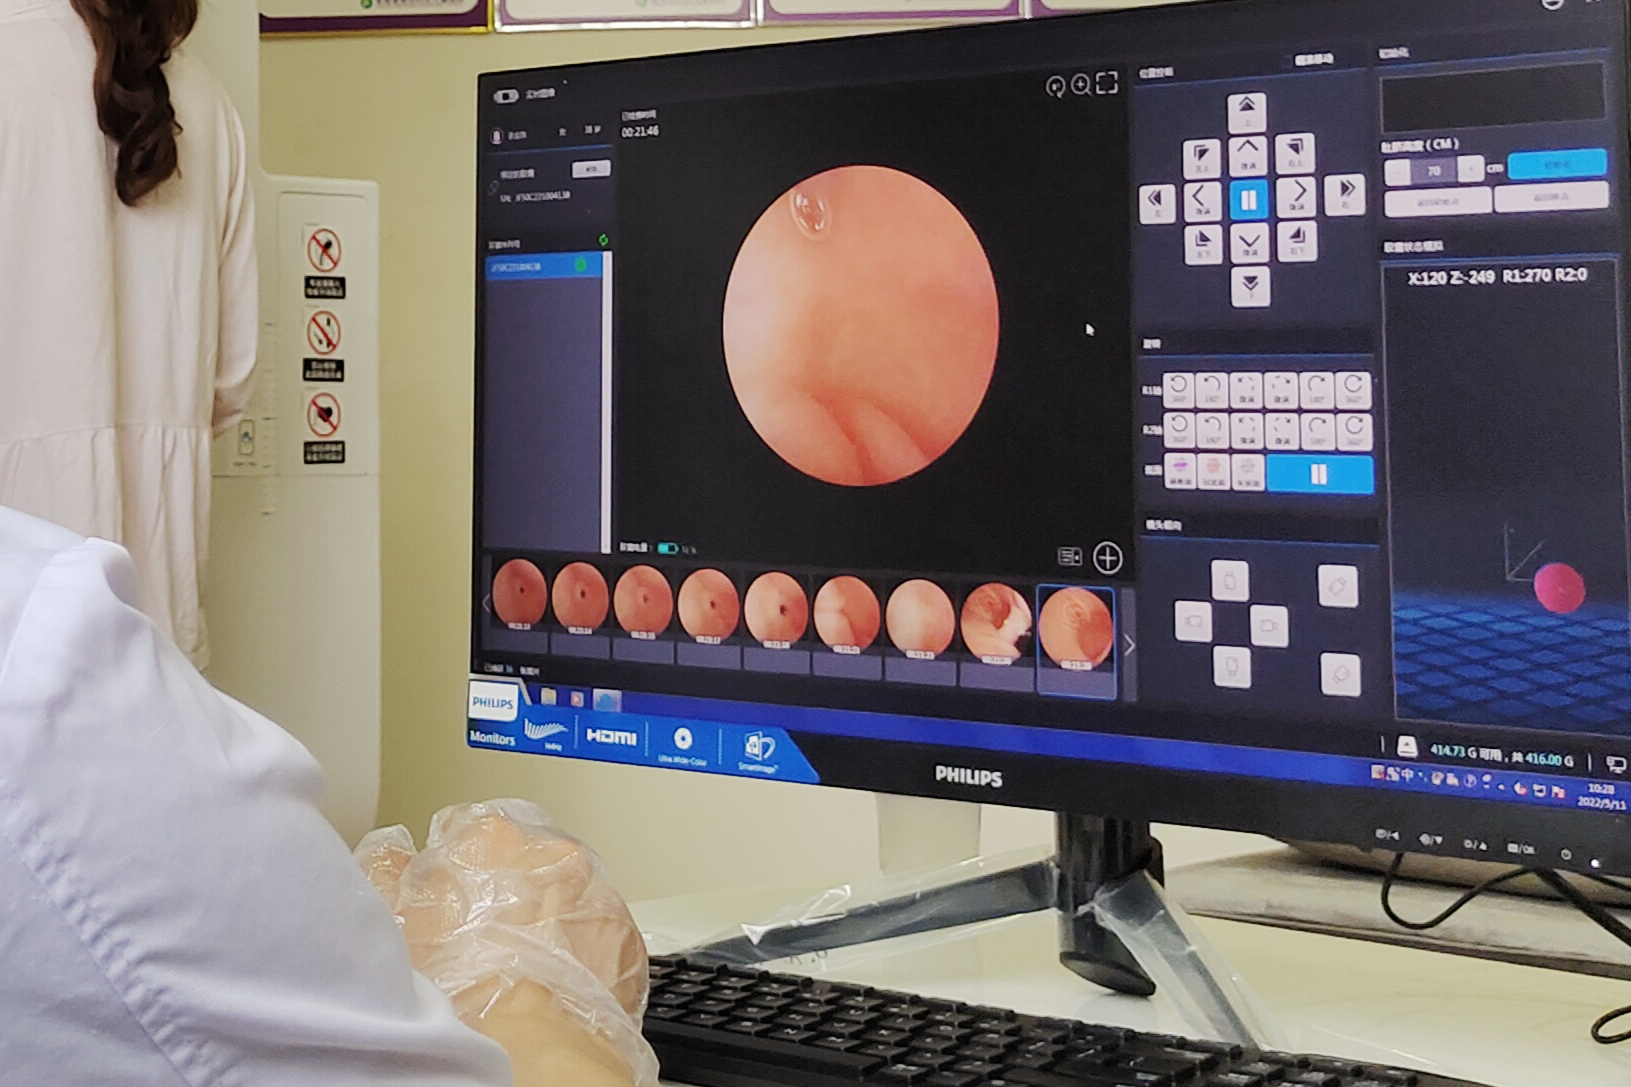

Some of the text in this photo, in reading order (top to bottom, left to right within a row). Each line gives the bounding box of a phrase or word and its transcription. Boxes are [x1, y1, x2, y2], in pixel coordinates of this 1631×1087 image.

[621, 124, 660, 138] 00:21:46
[1503, 268, 1552, 283] R1:270
[1555, 267, 1589, 282] R2:0
[472, 696, 514, 710] PHILIPS
[469, 730, 516, 747] Monitors
[586, 728, 637, 747] HDMI
[935, 765, 1003, 788] PHILIPS
